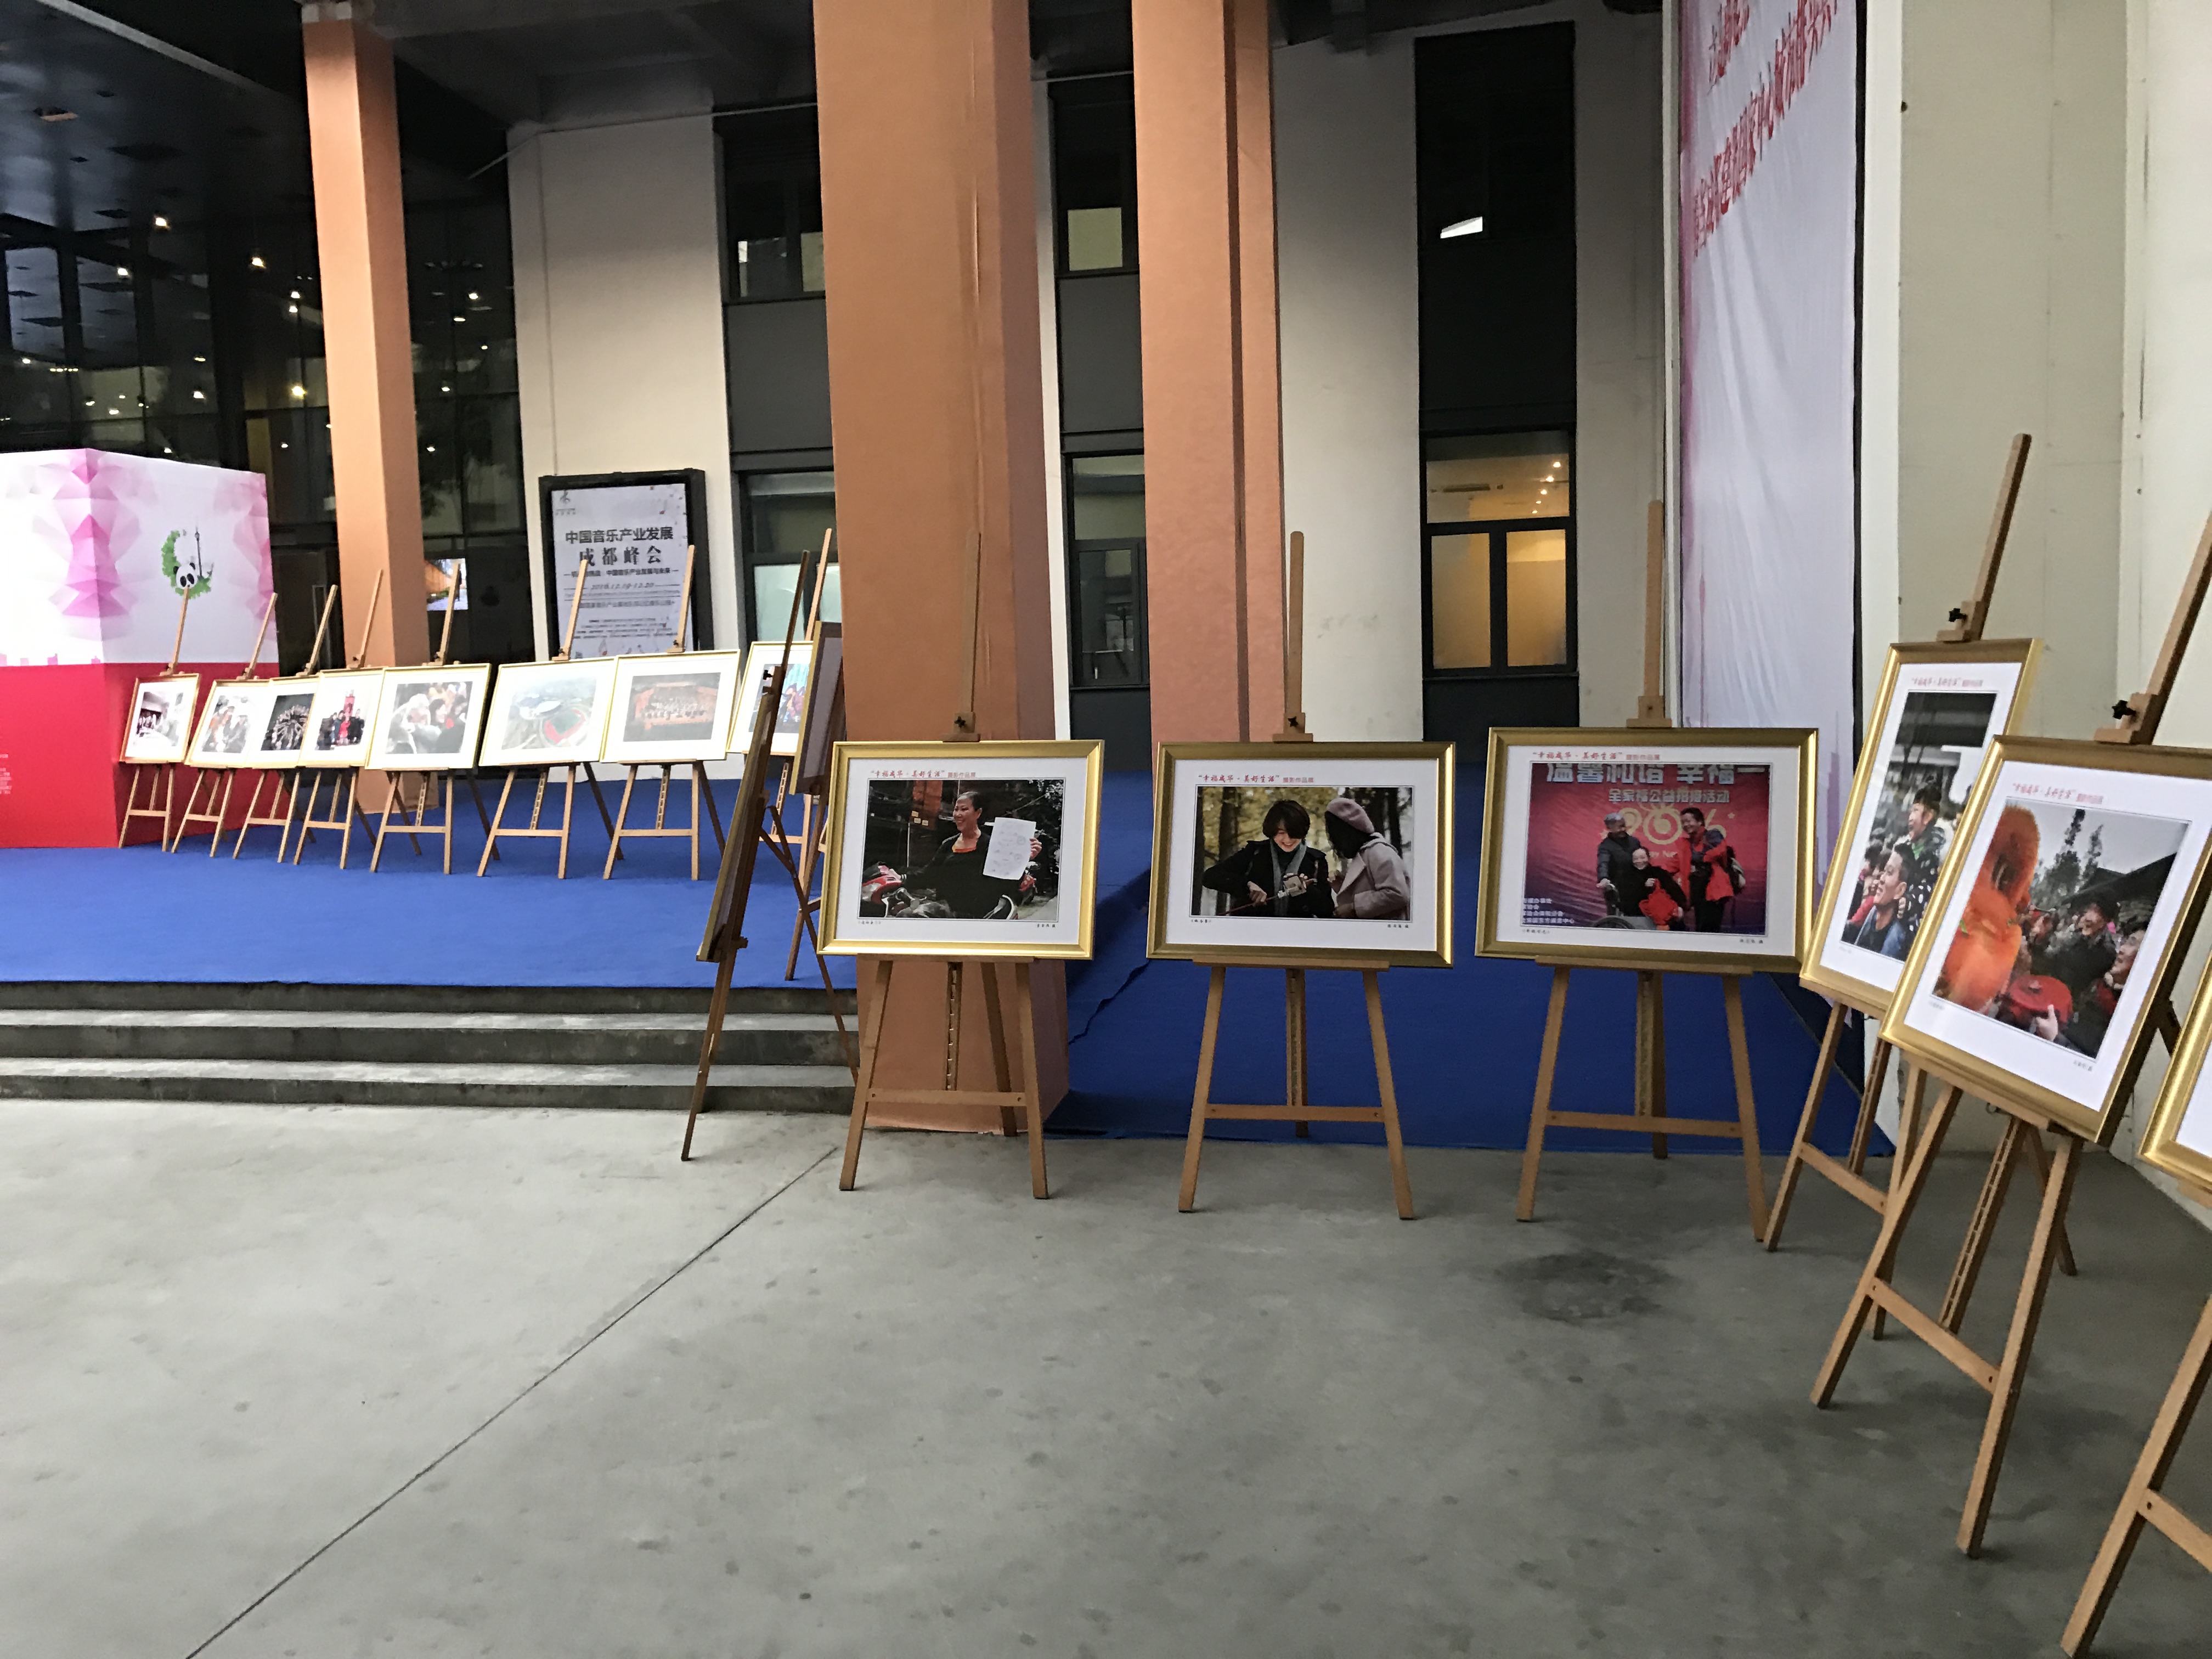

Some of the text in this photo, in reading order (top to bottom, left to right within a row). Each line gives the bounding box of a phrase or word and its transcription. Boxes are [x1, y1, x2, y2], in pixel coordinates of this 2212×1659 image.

[566, 527, 674, 544] 中国音乐产业发展
[579, 545, 661, 566] 成都峰会
